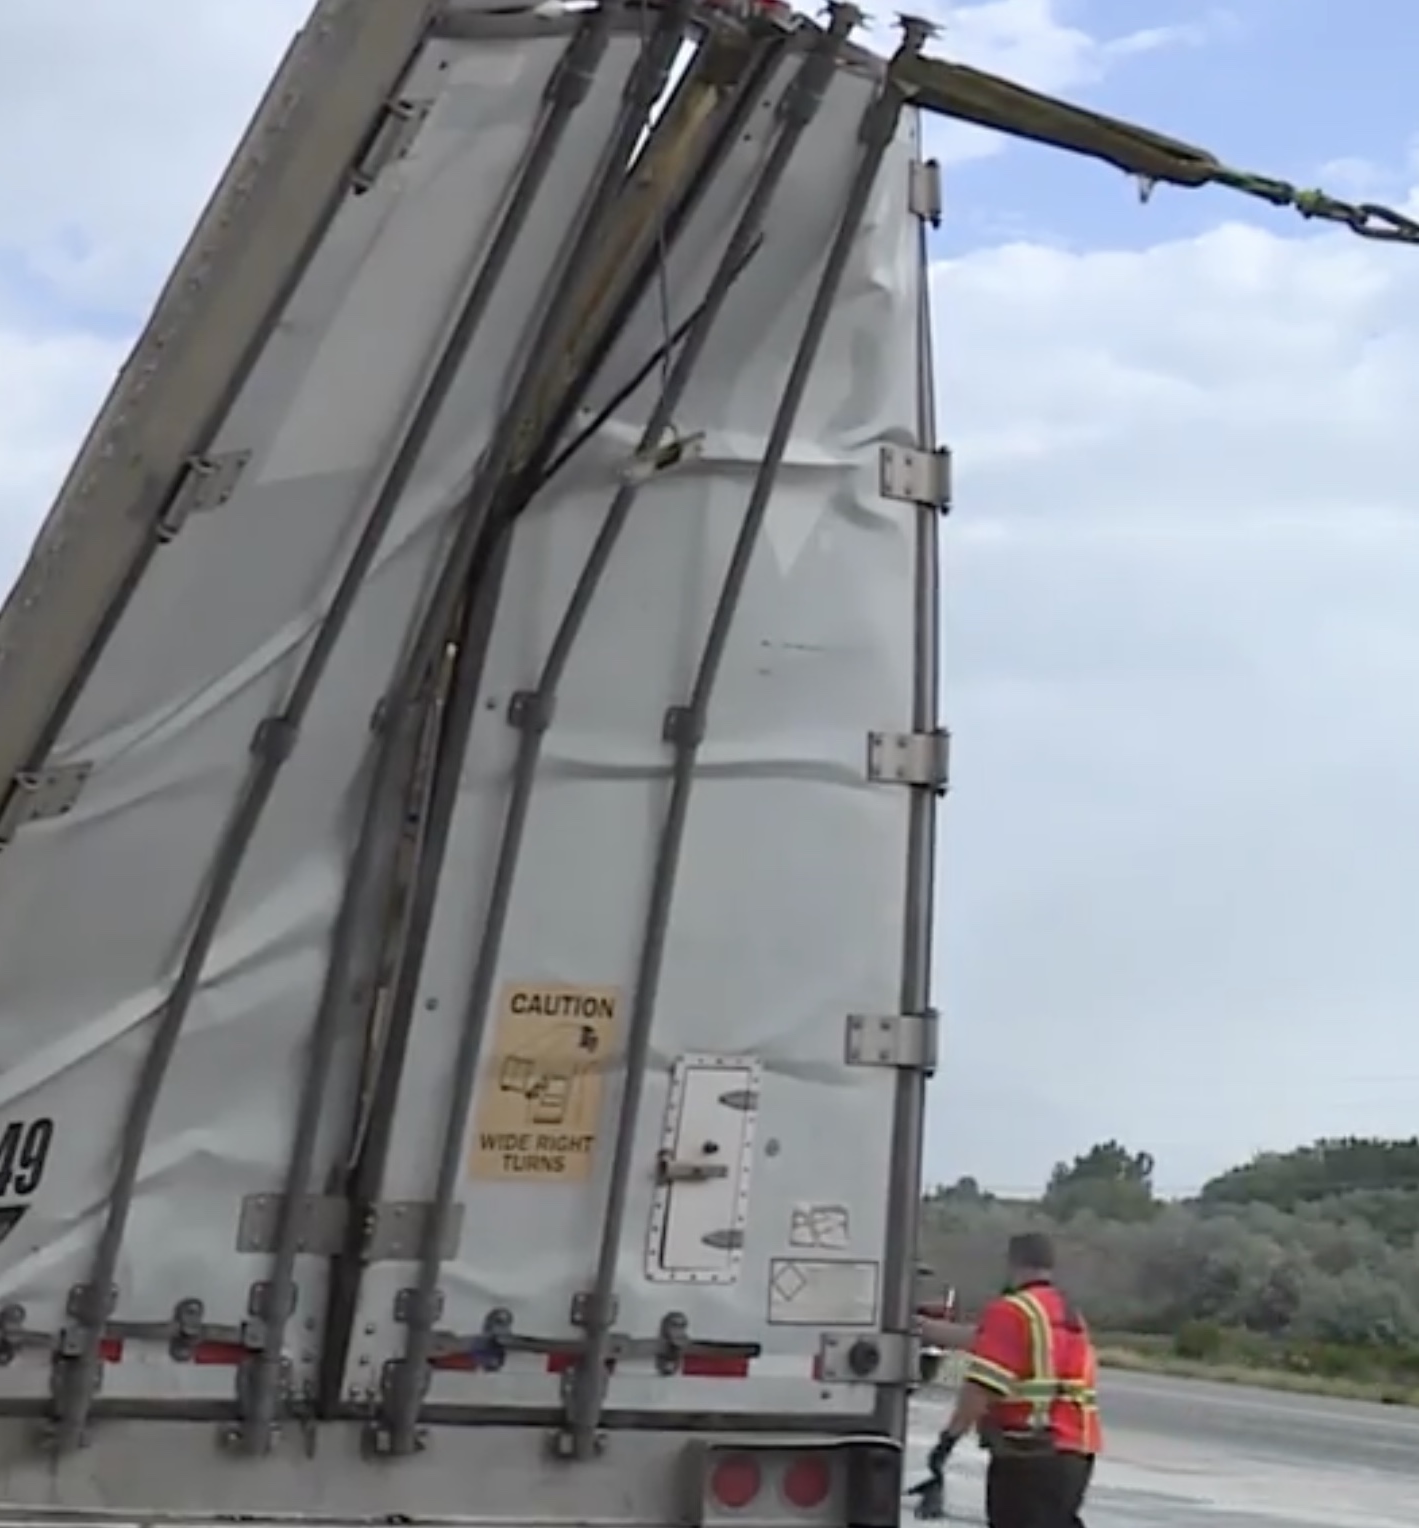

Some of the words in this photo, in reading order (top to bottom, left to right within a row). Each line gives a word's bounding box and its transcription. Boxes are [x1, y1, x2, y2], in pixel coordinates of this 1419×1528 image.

[510, 992, 615, 1018] CAUTION
[480, 1133, 533, 1151] WIDE
[536, 1134, 595, 1153] RIGHT
[502, 1154, 566, 1173] TURNS
